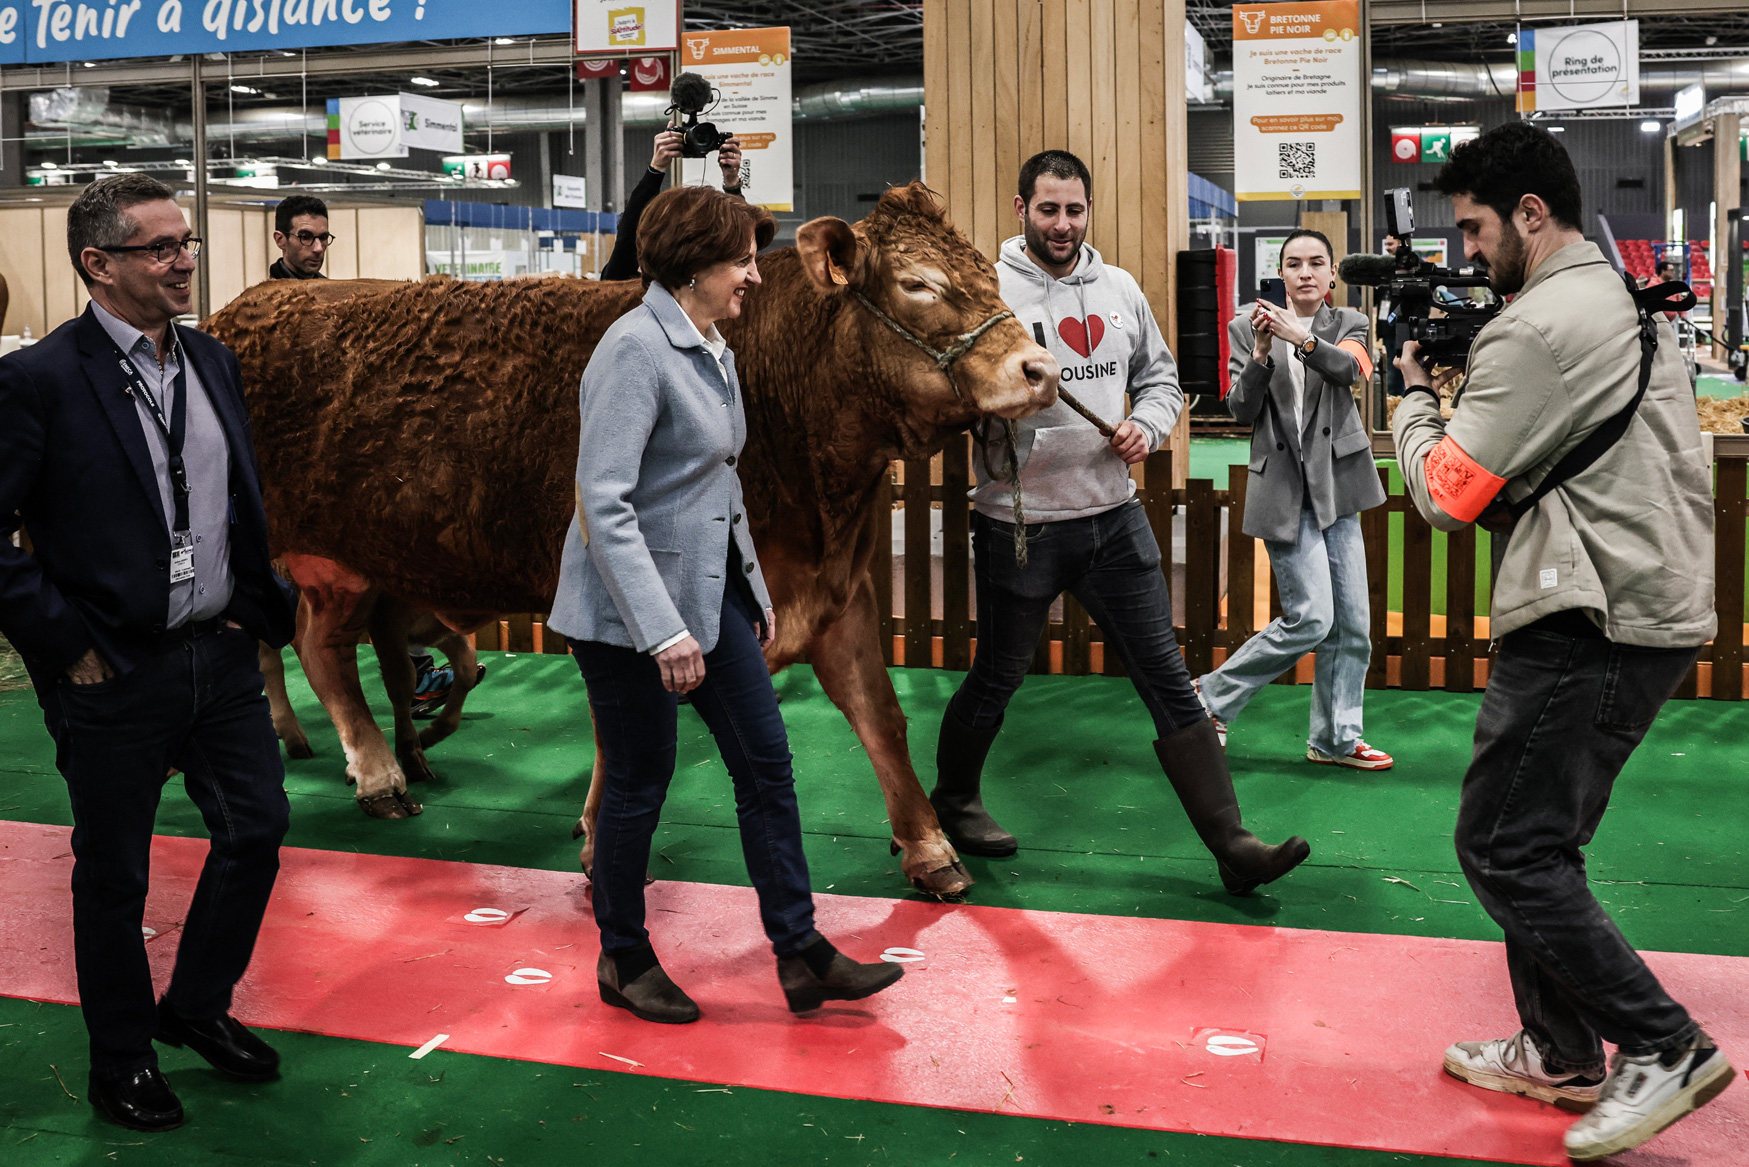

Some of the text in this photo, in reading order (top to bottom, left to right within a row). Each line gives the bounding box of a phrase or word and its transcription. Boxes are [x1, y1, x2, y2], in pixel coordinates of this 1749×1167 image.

[32, 0, 141, 49] Tenir
[1270, 14, 1321, 24] BRETONNE
[1270, 25, 1311, 34] PIE NOIR
[713, 45, 760, 55] SIMMENTAL
[1249, 50, 1257, 58] Je
[1564, 55, 1604, 68] Ring de
[1552, 65, 1617, 78] présentation
[1290, 82, 1305, 90] pour
[359, 119, 386, 128] Service
[425, 118, 458, 132] Simmental
[434, 262, 502, 274] VEEINAIRE
[1032, 322, 1047, 349] I
[1060, 361, 1117, 382] OUSINE
[136, 380, 155, 407] PROTOCOLE
